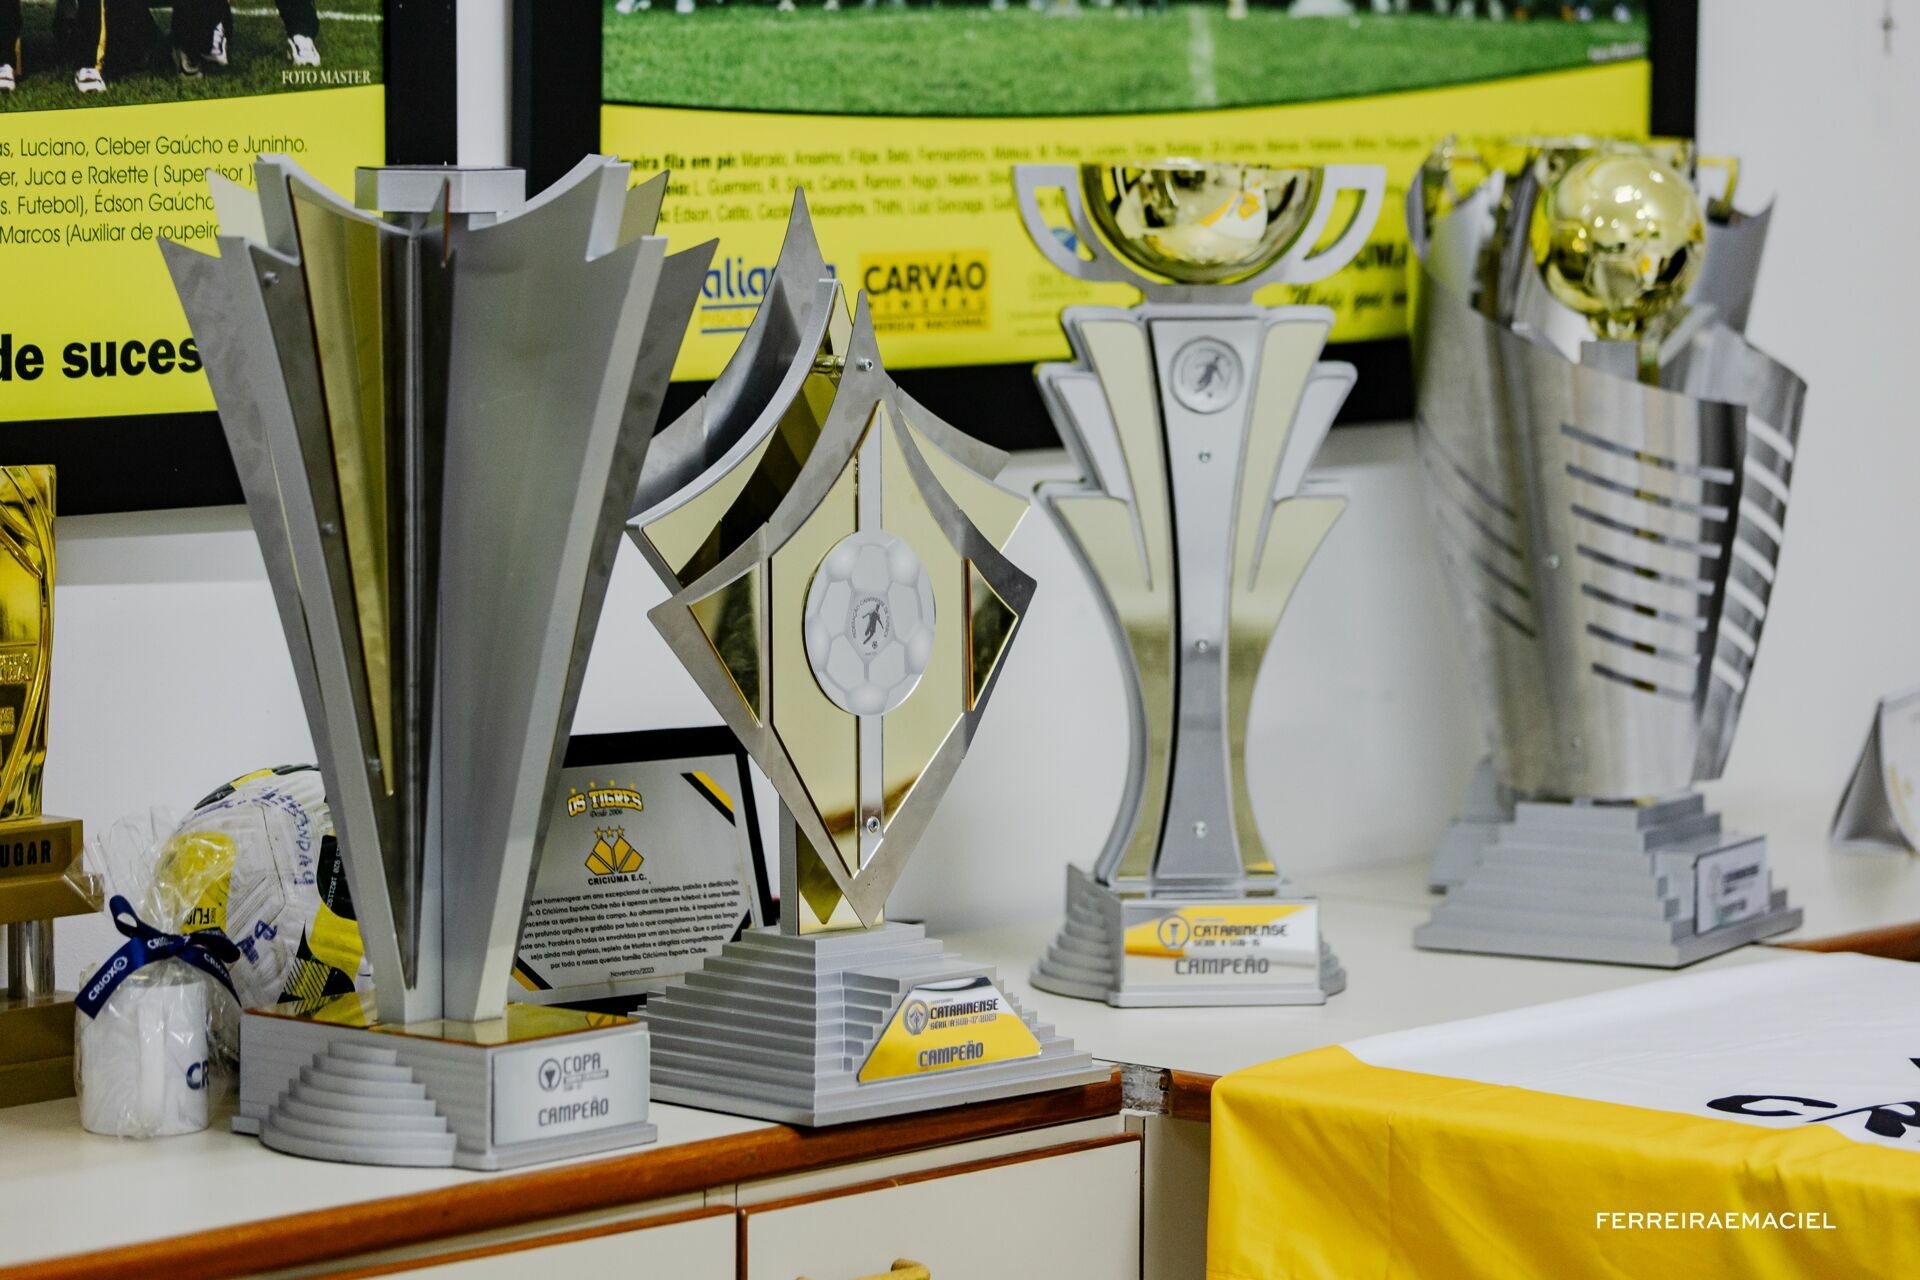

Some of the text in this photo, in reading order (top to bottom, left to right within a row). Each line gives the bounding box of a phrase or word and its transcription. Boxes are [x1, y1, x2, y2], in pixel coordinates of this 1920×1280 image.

[282, 69, 371, 84] FOTO MASTER
[20, 138, 89, 157] Luciano,
[95, 137, 150, 156] Cleber
[155, 134, 223, 155] Gaúcho
[228, 140, 238, 154] e
[243, 135, 308, 154] Juninho.
[24, 167, 66, 186] Juca
[72, 170, 83, 185] e
[88, 165, 149, 185] Rakette
[163, 163, 243, 186] Superisor
[18, 196, 88, 215] Futebol),
[95, 189, 143, 213] Édson
[0, 225, 60, 244] Marcos
[66, 223, 125, 247] (Auxiliar
[130, 223, 153, 241] de
[863, 252, 988, 296] CARVÃO
[62, 337, 205, 379] suces
[567, 788, 643, 817] OS TIGRES
[0, 839, 51, 868] UGAR
[631, 873, 648, 882] E.C.
[544, 895, 582, 904] homenagear
[605, 889, 641, 899] excepcional
[682, 882, 702, 891] paixão
[708, 879, 739, 888] dedicação
[542, 906, 568, 916] Criciúma
[569, 905, 590, 914] Esporte
[591, 903, 608, 911] Clube
[609, 901, 621, 909] não
[627, 899, 648, 908] apenas
[559, 916, 579, 925] quatro
[579, 914, 596, 922] linhas
[605, 911, 628, 921] campo.
[664, 907, 679, 915] para
[534, 929, 561, 939] profundo
[562, 927, 584, 936] orgulho
[590, 923, 615, 933] gratidão
[615, 922, 625, 930] por
[625, 920, 639, 928] tudo
[645, 920, 657, 928] que
[722, 911, 739, 919] longo
[548, 939, 575, 948] Parabéns
[581, 936, 598, 944] todos
[606, 932, 637, 942] envolvidos
[637, 931, 647, 939] por
[692, 925, 705, 933] Que
[711, 923, 734, 932] próximo
[1193, 923, 1288, 937] CATARINENSE
[530, 953, 543, 961] seja
[544, 951, 561, 959] ainda
[561, 949, 575, 957] mais
[576, 947, 600, 957] glorioso,
[601, 945, 622, 954] repleto
[631, 941, 652, 950] triunfos
[657, 938, 680, 948] alegrias
[550, 962, 561, 970] por
[561, 960, 575, 968] toda
[581, 958, 599, 966] nossa
[599, 956, 621, 965] querida
[621, 953, 641, 962] família
[642, 950, 668, 960] Criciúma
[668, 948, 689, 958] Esporte
[690, 946, 708, 955] Clube.
[1174, 953, 1270, 975] CAMPEÃO
[929, 998, 999, 1020] CATARINENSE
[563, 1052, 601, 1075] COPA
[918, 1040, 984, 1068] CAMPEÃO
[538, 1096, 609, 1127] CAMPEÃO
